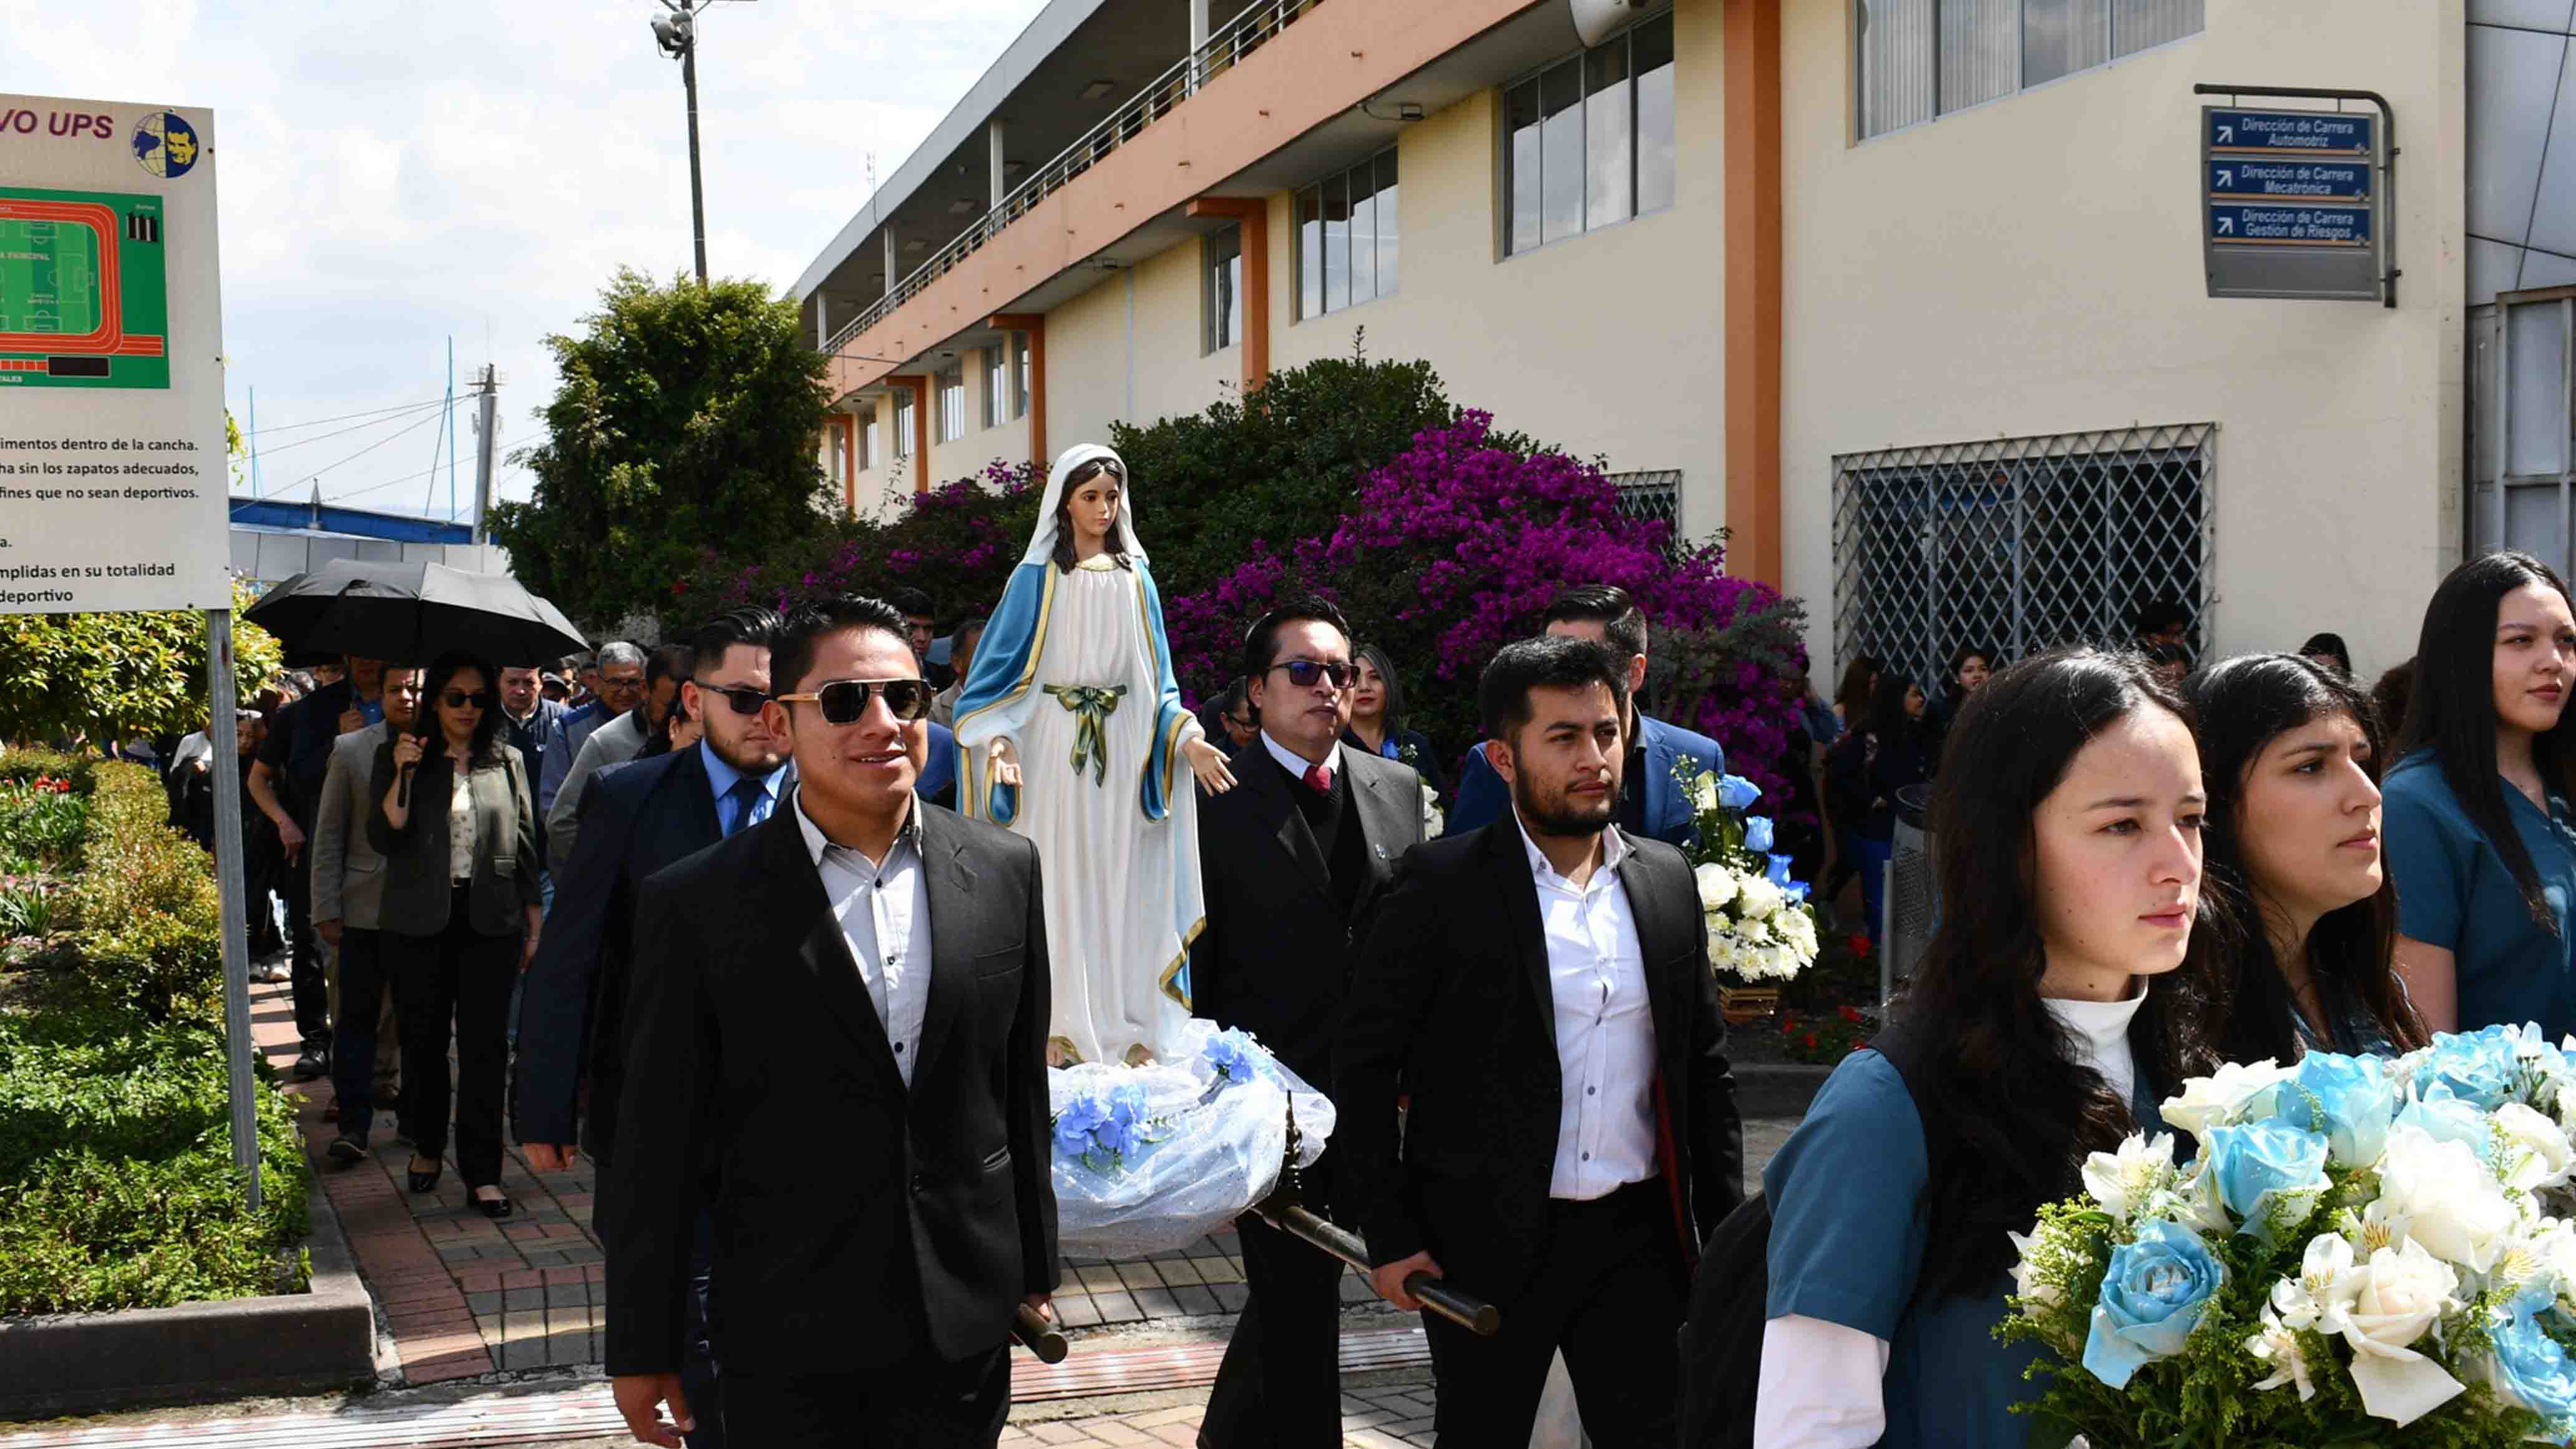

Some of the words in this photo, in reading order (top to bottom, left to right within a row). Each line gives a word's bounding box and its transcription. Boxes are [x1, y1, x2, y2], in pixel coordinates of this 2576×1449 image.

[49, 112, 114, 139] UPS
[2242, 117, 2294, 133] Dirección
[2297, 121, 2311, 132] de
[2314, 119, 2354, 134] Carrera
[2242, 165, 2294, 180] Dirección
[2296, 168, 2310, 180] de
[2313, 167, 2354, 181] Carrera
[2265, 180, 2332, 195] Mecatrónica
[2242, 209, 2294, 223] Dirección
[2296, 212, 2311, 224] de
[2314, 211, 2354, 225] Carrera
[2291, 225, 2305, 237] de
[0, 437, 57, 449] imentos
[61, 438, 107, 451] dentro
[111, 438, 129, 451] de
[132, 438, 144, 451] la
[148, 439, 198, 451] cancha.
[19, 462, 39, 474] sin
[43, 462, 62, 474] los
[67, 464, 119, 477] zapatos
[123, 462, 199, 476] adecuados,
[0, 487, 31, 499] fines
[36, 489, 62, 501] que
[66, 490, 84, 499] no
[87, 489, 119, 499] sean
[124, 487, 199, 501] deportivos.
[0, 565, 57, 581] mplidas
[61, 568, 80, 578] en
[85, 567, 102, 577] su
[106, 563, 175, 577] totalidad
[0, 589, 74, 605] deportivo
